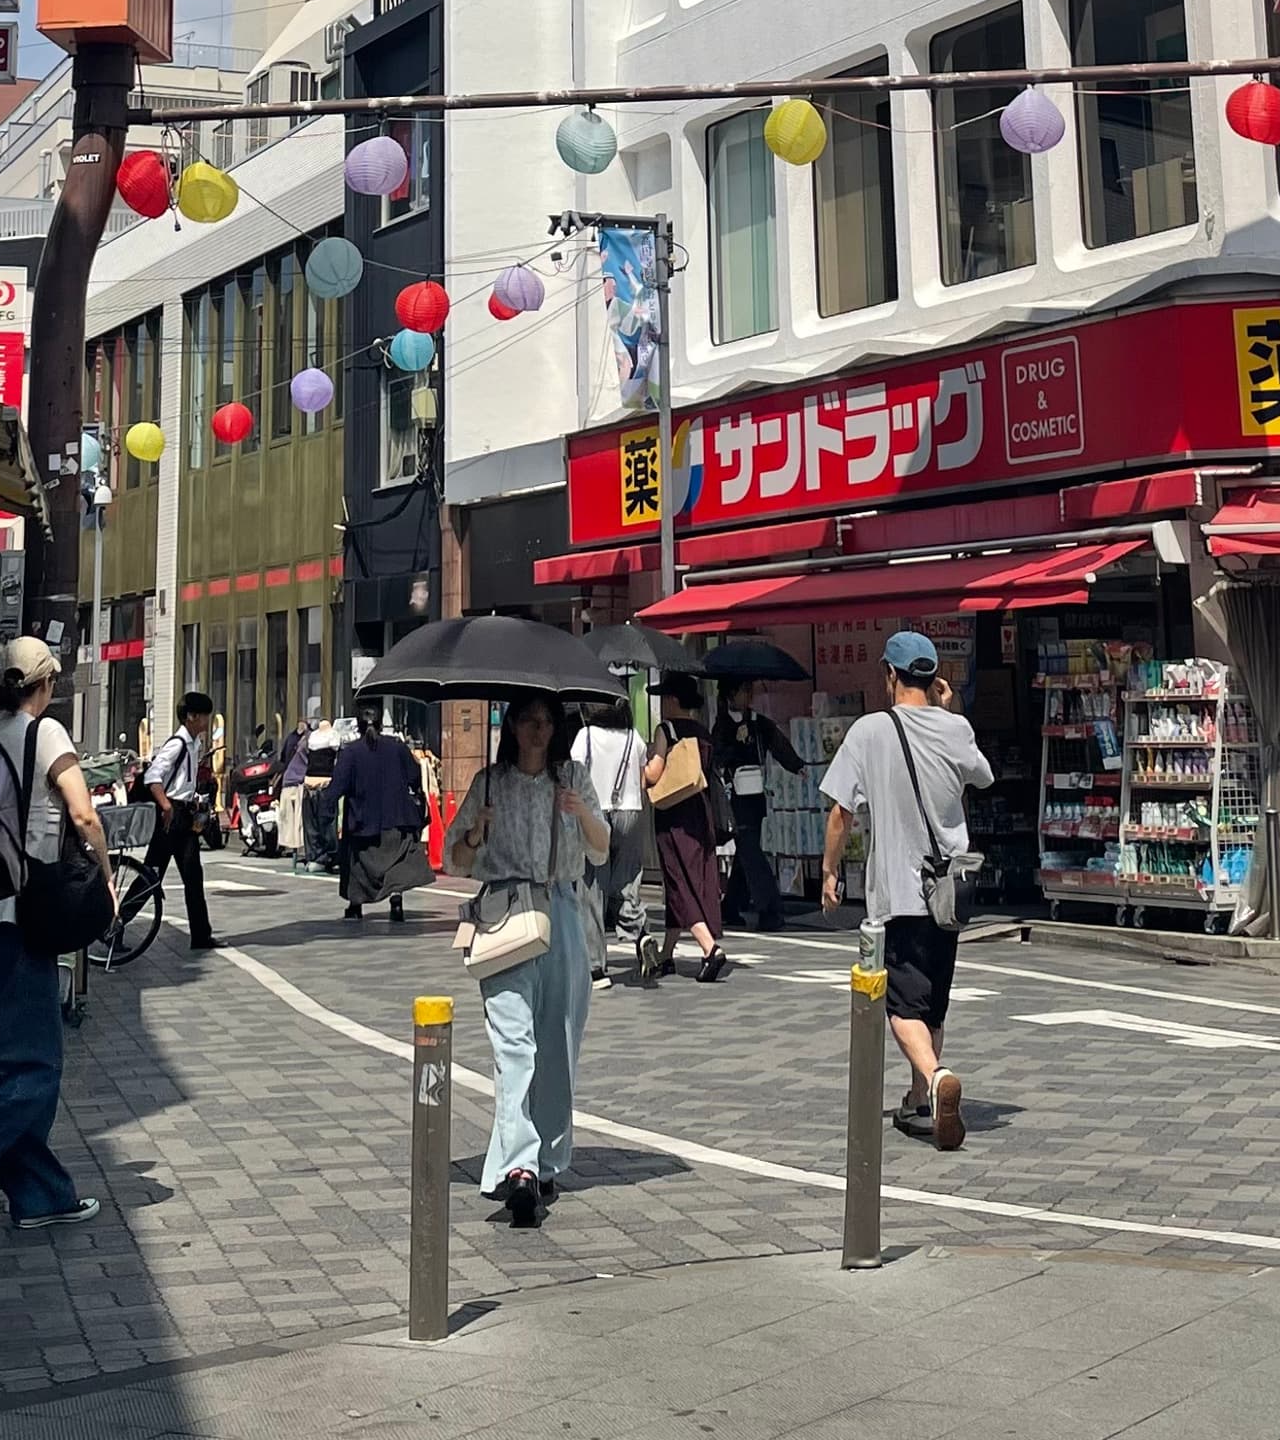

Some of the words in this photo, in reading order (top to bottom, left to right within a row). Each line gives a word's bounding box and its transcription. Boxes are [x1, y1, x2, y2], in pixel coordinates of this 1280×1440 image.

[1015, 357, 1065, 384] DRUG
[1037, 392, 1048, 411] &
[714, 360, 985, 506] サンドラッグ
[1011, 412, 1078, 445] COSMETIC
[622, 435, 661, 517] 薬
